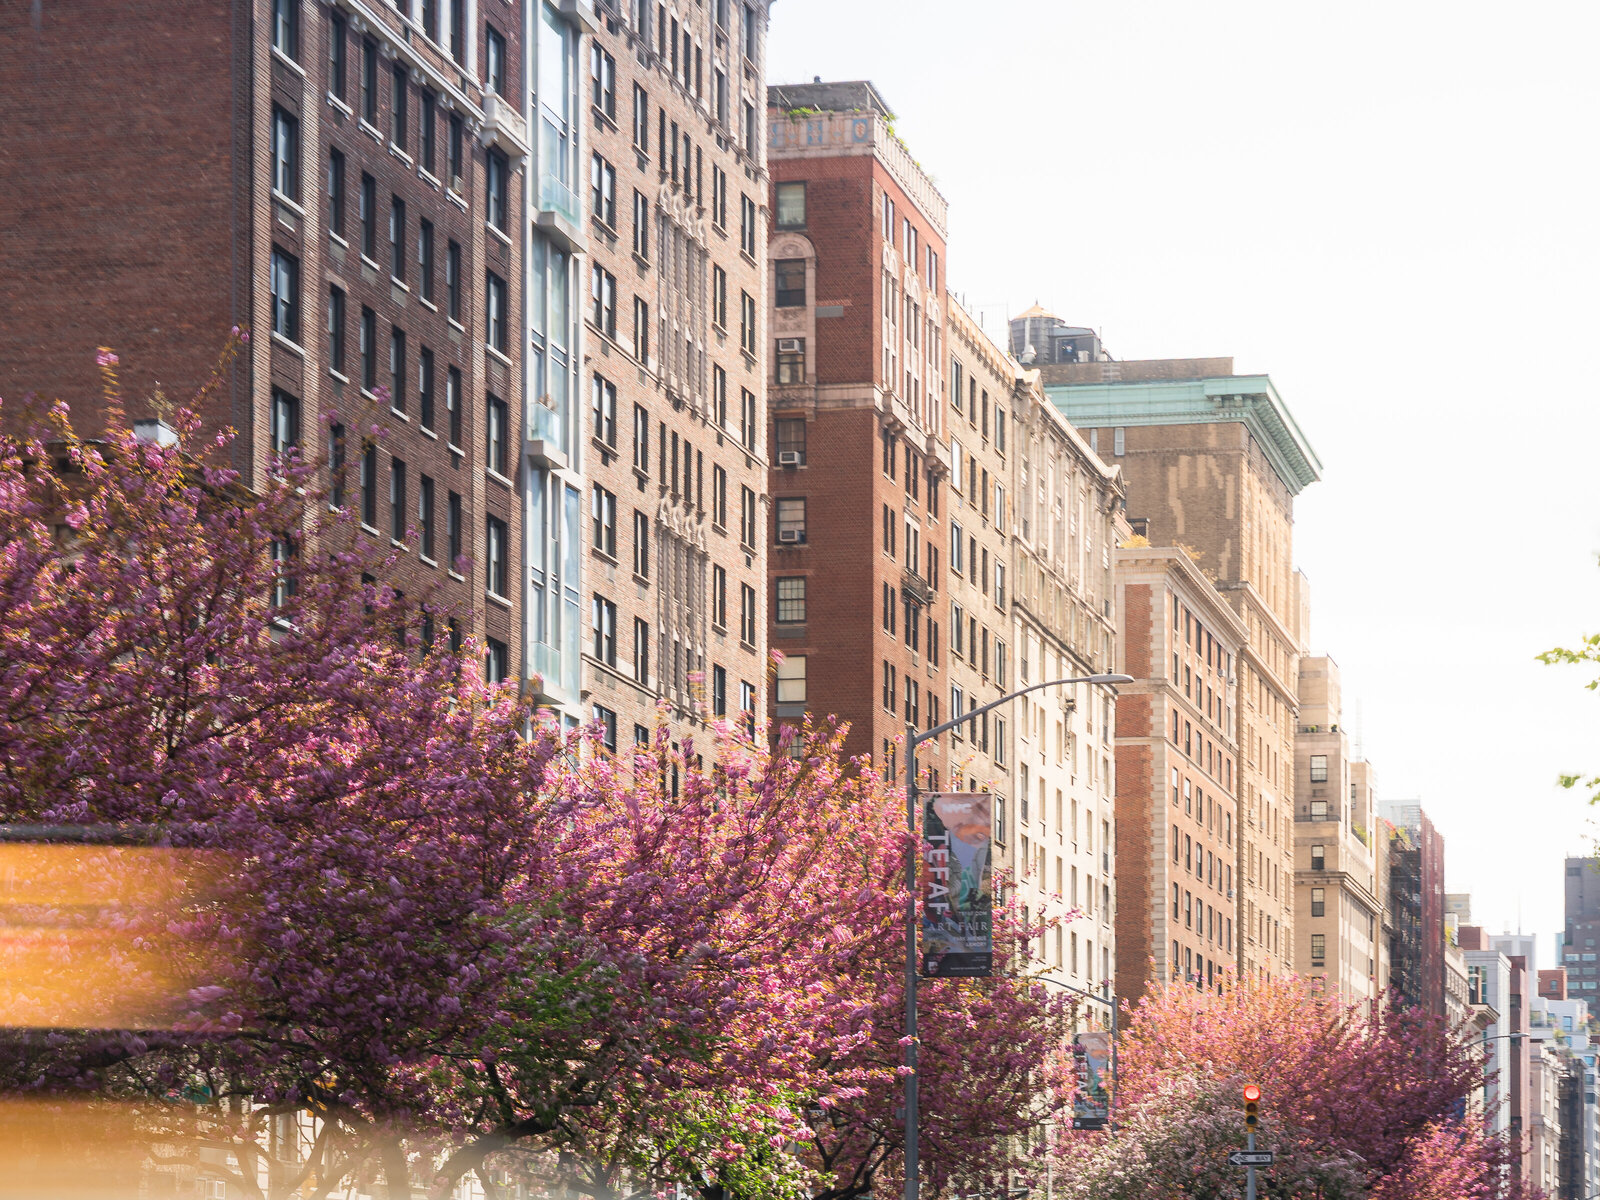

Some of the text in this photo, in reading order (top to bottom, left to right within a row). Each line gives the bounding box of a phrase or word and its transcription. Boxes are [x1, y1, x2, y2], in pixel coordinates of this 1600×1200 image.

[928, 830, 950, 916] TEFAF
[928, 921, 988, 931] ART FAIR
